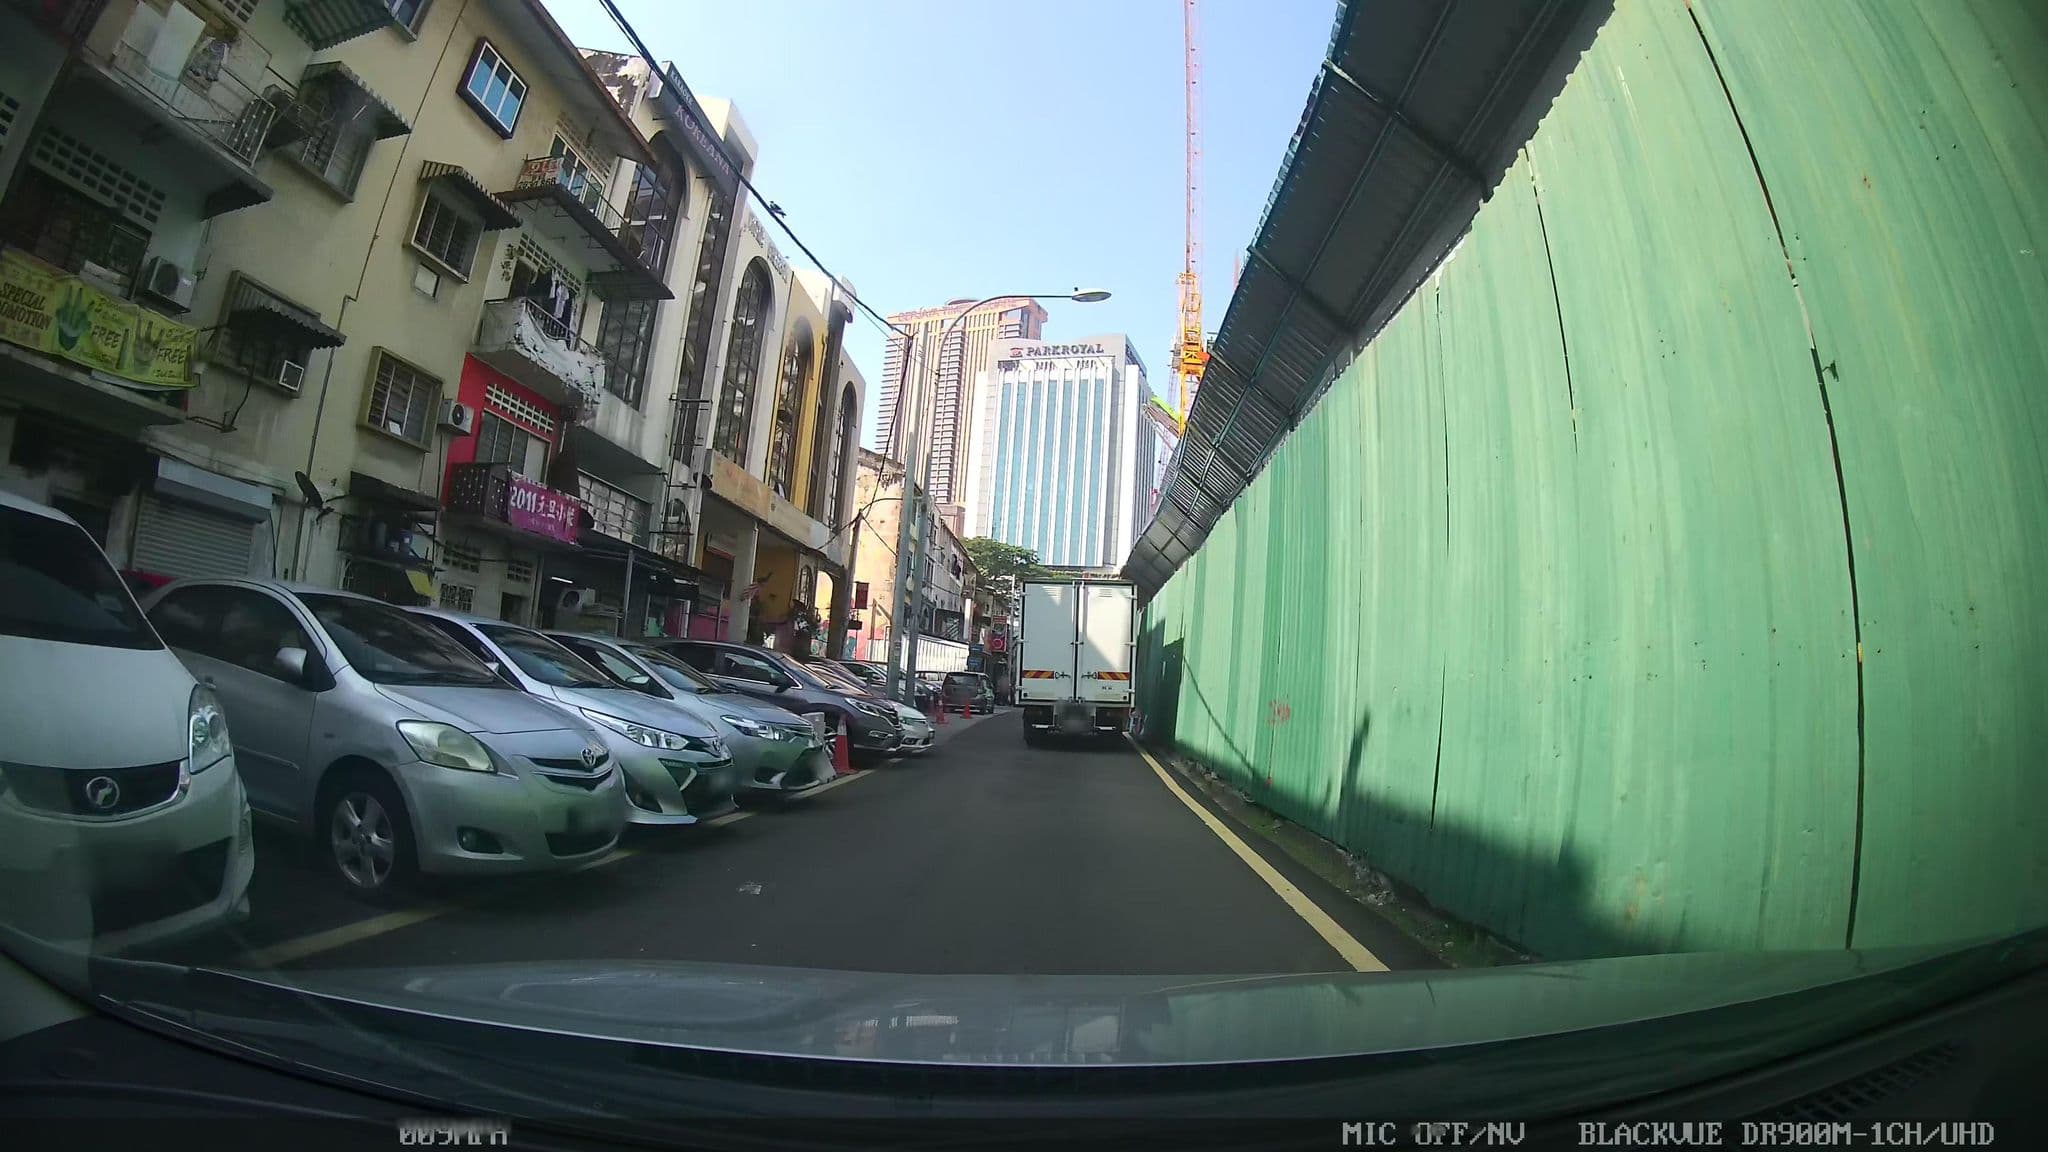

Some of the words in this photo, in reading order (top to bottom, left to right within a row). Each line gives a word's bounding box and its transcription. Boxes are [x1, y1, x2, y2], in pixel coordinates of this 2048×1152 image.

[0, 282, 46, 311] SPECIAL
[92, 324, 121, 348] FREE
[157, 347, 187, 364] FREE
[1026, 343, 1104, 357] PARKROYAL
